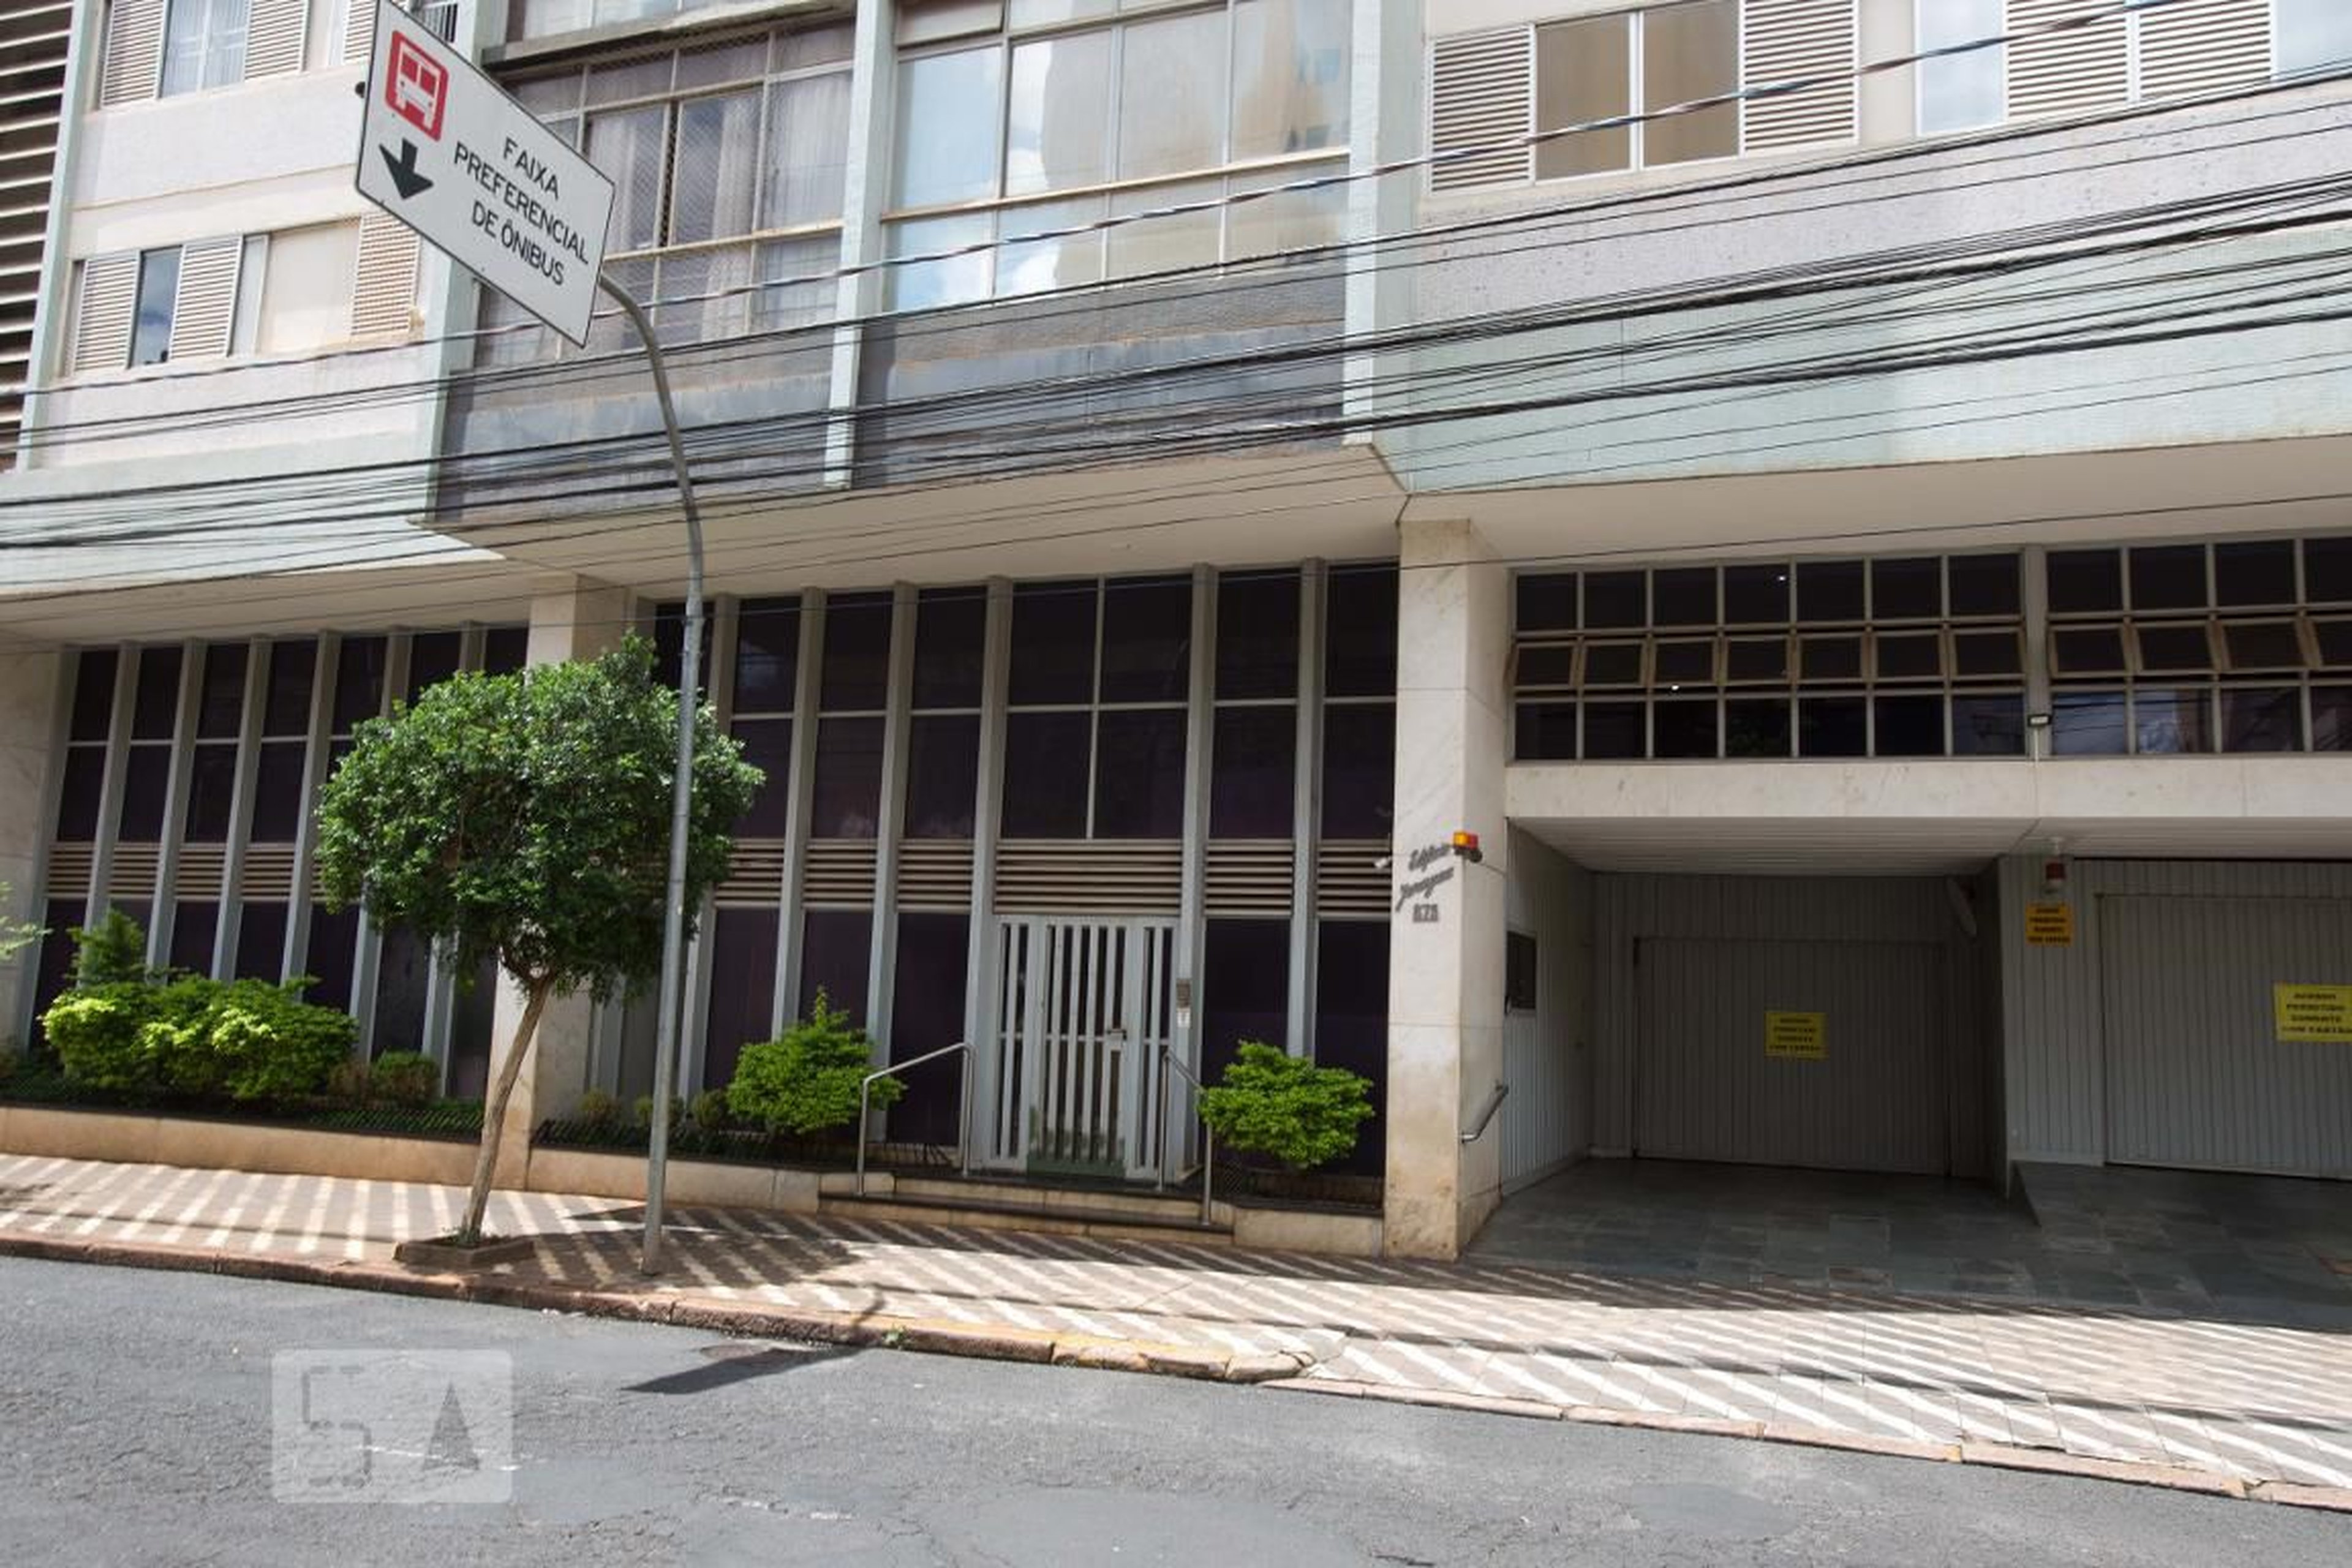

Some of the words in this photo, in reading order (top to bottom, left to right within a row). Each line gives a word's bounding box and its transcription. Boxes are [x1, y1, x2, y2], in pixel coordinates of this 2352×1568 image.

[454, 141, 589, 265] PREFERENCIAL
[503, 137, 559, 201] FAIXA
[472, 200, 499, 239] DE
[501, 219, 564, 286] ÔNIBUS
